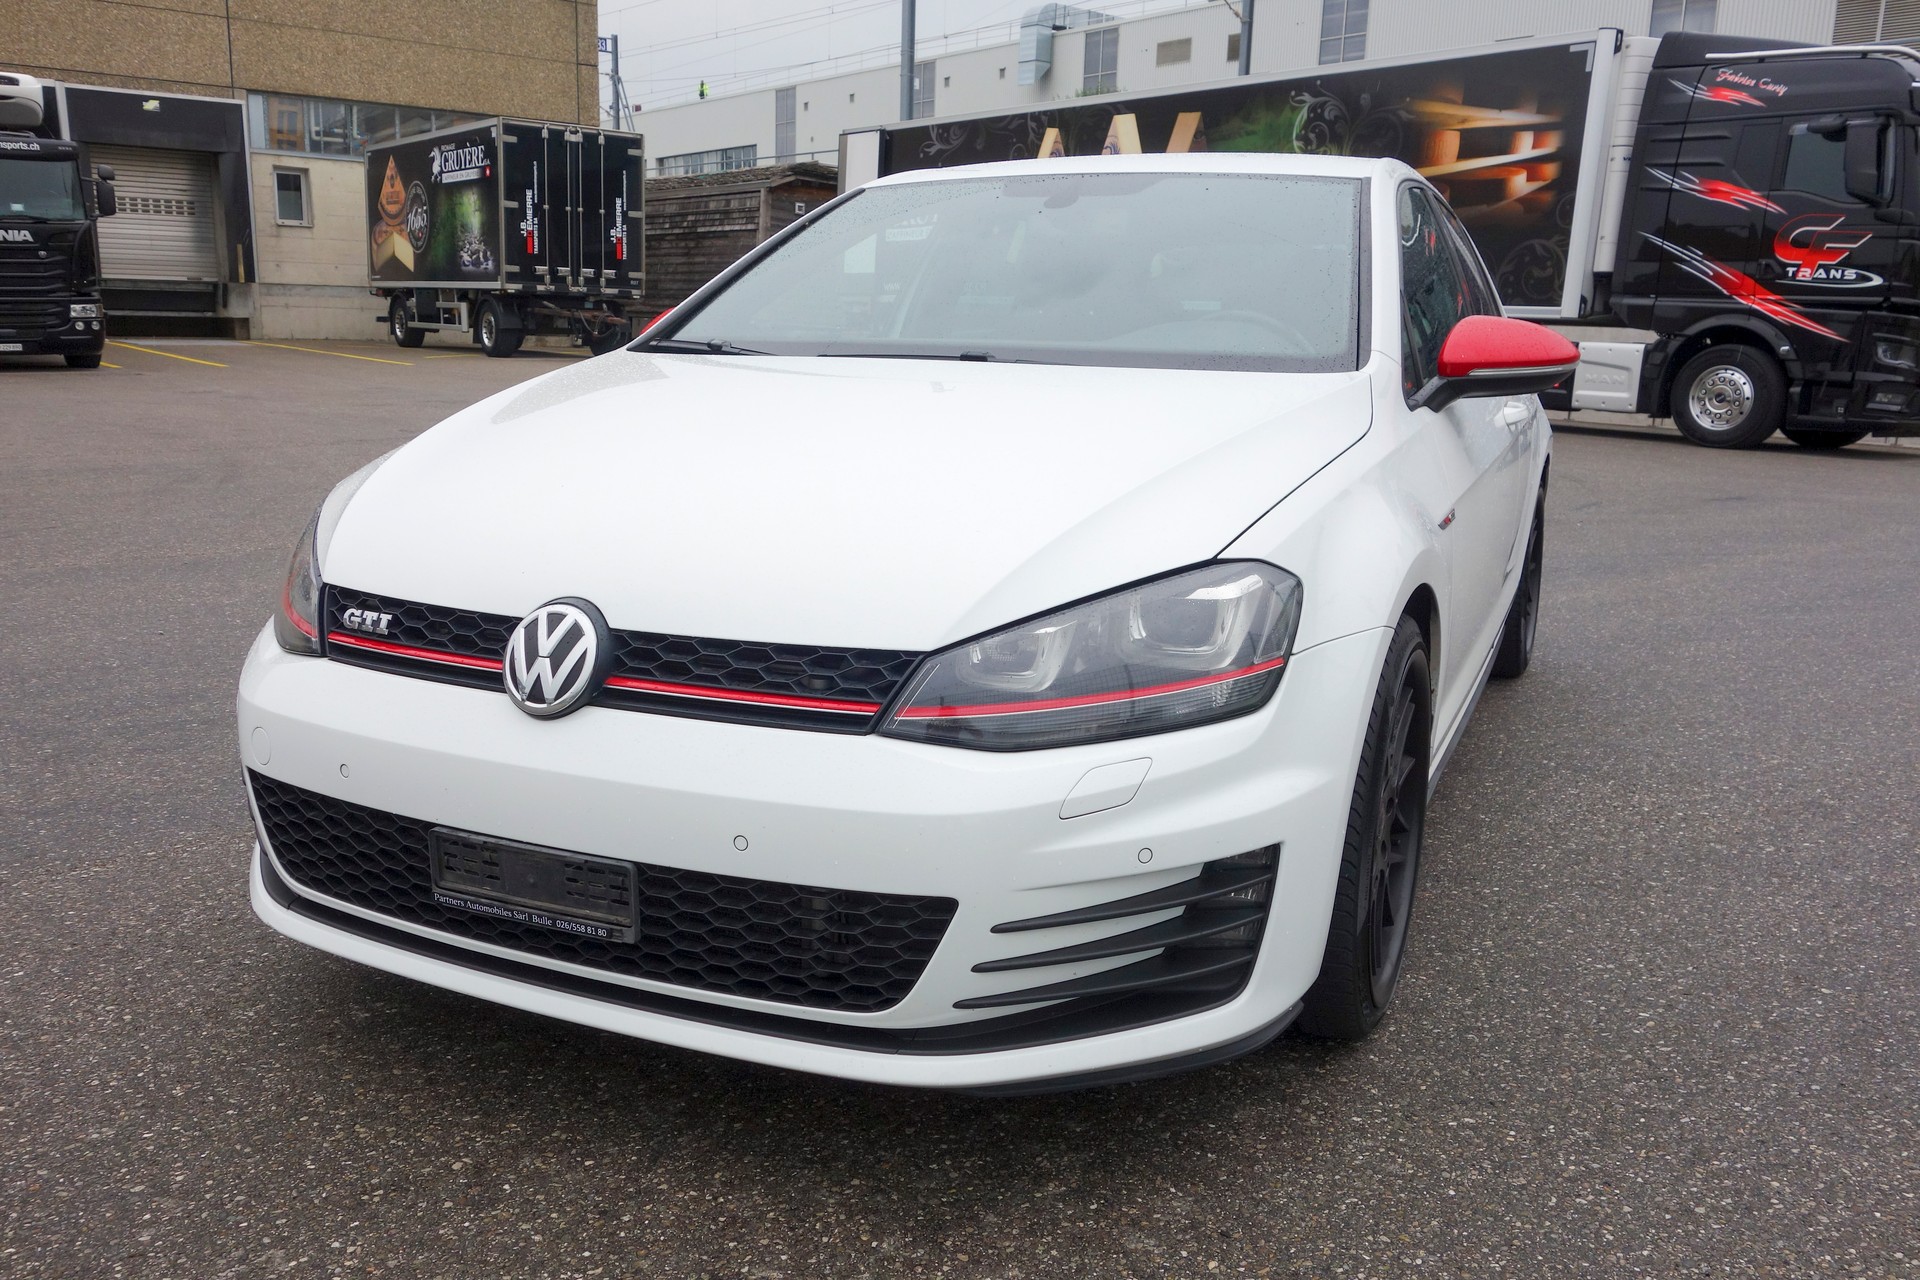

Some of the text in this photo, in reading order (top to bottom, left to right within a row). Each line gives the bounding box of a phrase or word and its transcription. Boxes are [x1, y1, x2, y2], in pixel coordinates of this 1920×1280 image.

[441, 141, 485, 172] GRUYÈRE
[1785, 266, 1858, 281] TRANS
[342, 608, 393, 635] GTI
[434, 892, 464, 908] Partners
[466, 900, 512, 918] Automobiles
[532, 914, 552, 926] Bulle
[556, 919, 586, 933] 026/558
[586, 925, 596, 935] 81
[597, 927, 607, 937] 80
